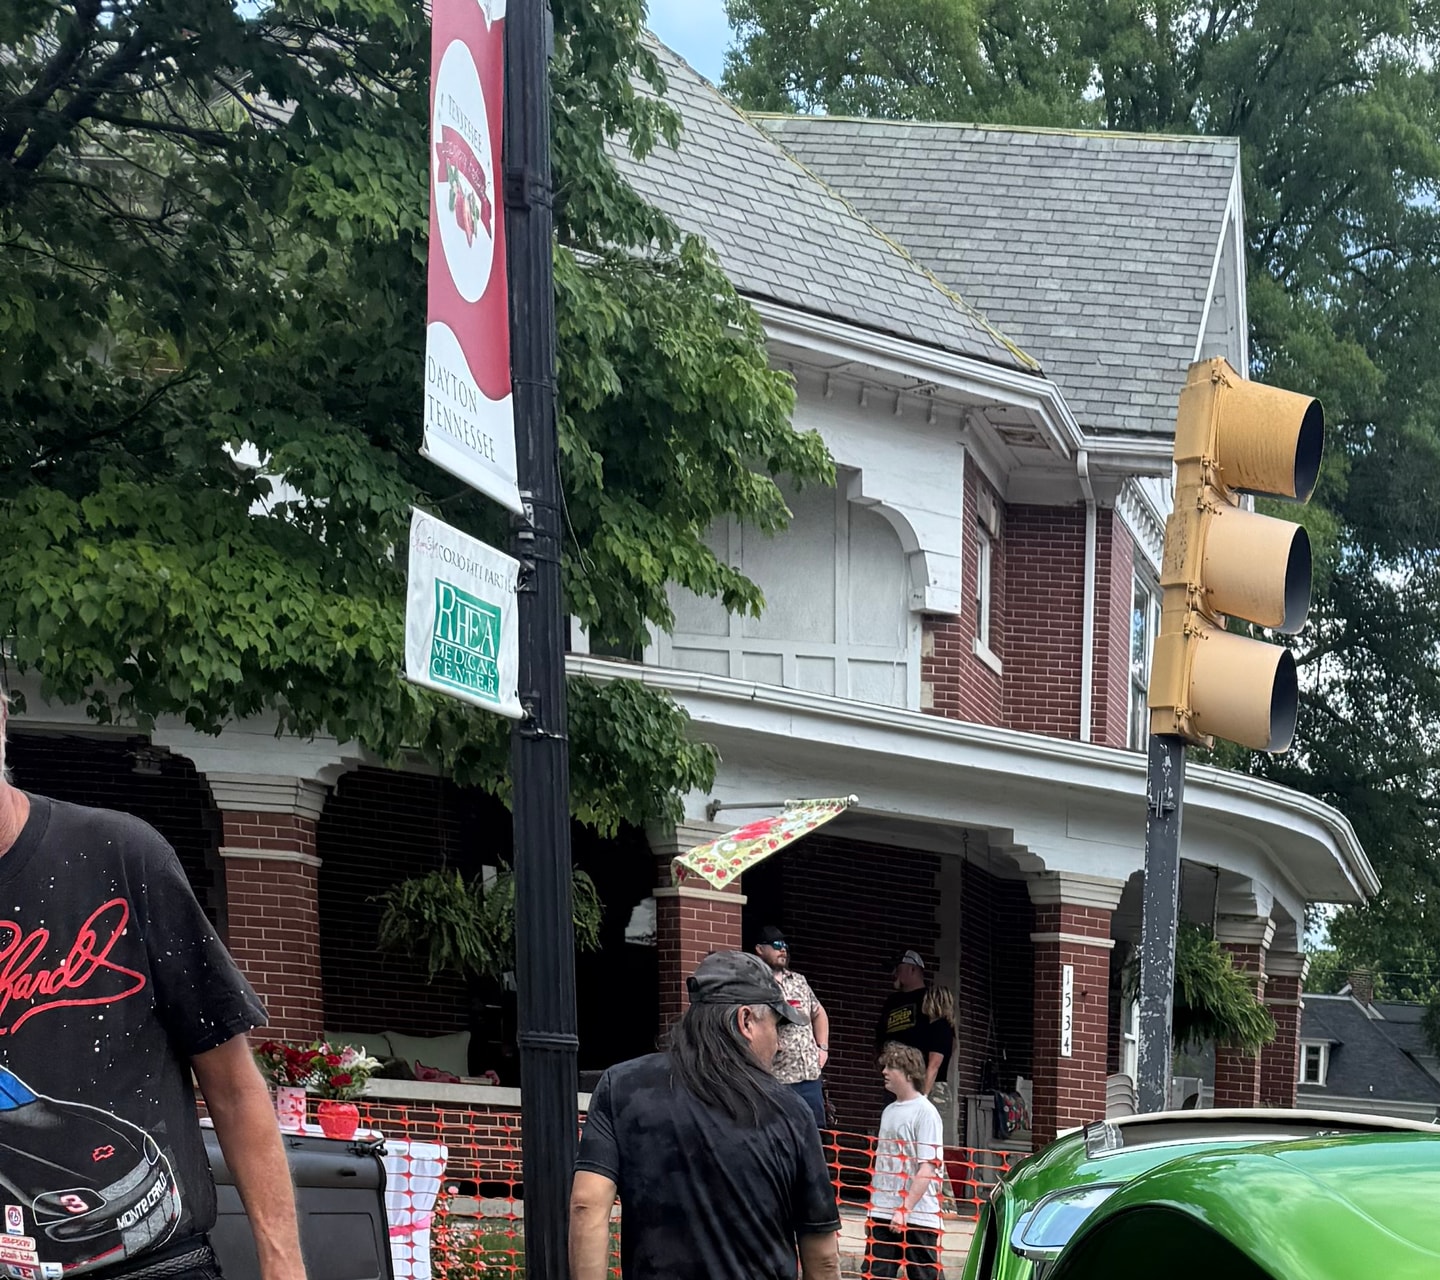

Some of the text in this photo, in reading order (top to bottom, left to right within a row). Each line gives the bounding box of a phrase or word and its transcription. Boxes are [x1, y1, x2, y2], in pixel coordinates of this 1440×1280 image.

[427, 354, 478, 416] DAYTON
[427, 393, 496, 463] TENNESSEE
[435, 583, 497, 659] RHEA
[431, 657, 496, 694] CENTER
[433, 639, 496, 678] MEDICAL
[1063, 969, 1072, 1053] 1534
[60, 1194, 89, 1214] 3
[116, 1171, 167, 1230] MONTE CARLO
